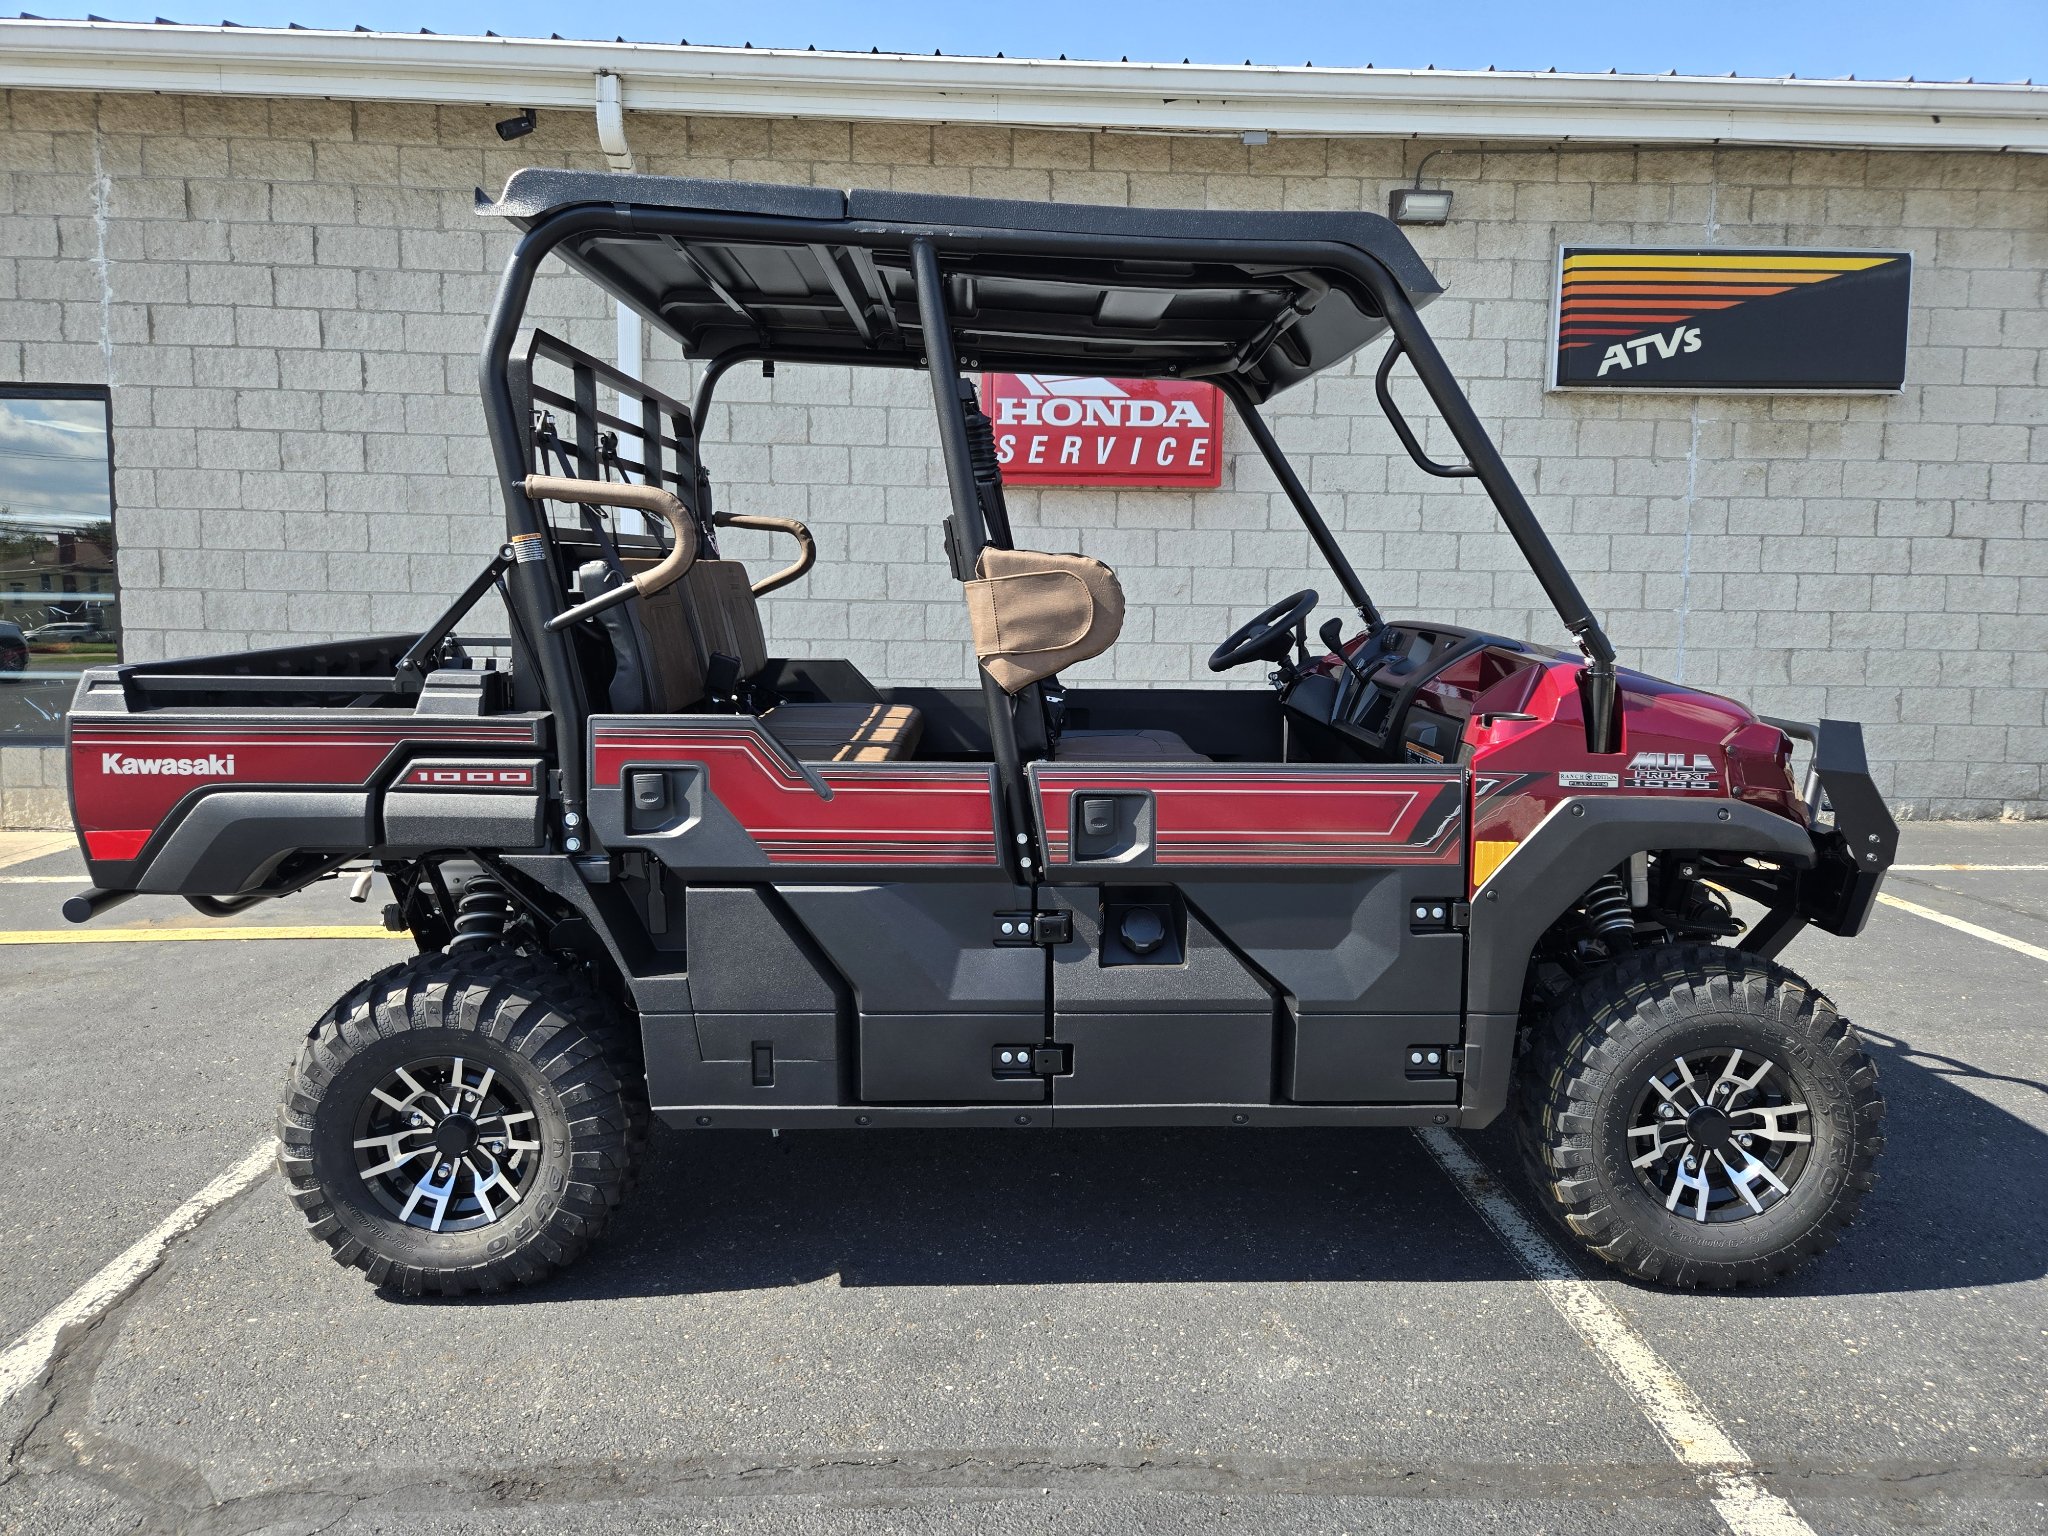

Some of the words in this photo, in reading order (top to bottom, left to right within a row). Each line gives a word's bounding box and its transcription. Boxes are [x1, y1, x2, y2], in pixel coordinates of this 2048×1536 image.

[1596, 325, 1702, 378] ATVs
[996, 398, 1210, 428] HONDA
[997, 434, 1209, 466] SERVICE
[102, 752, 235, 776] Kawasaki
[1625, 752, 1718, 773] MULE
[1634, 771, 1709, 780] PRO-FXT
[417, 772, 527, 782] 1000
[1634, 780, 1710, 789] 1000
[1818, 1074, 1851, 1196] DURO
[487, 1163, 564, 1256] DURO
